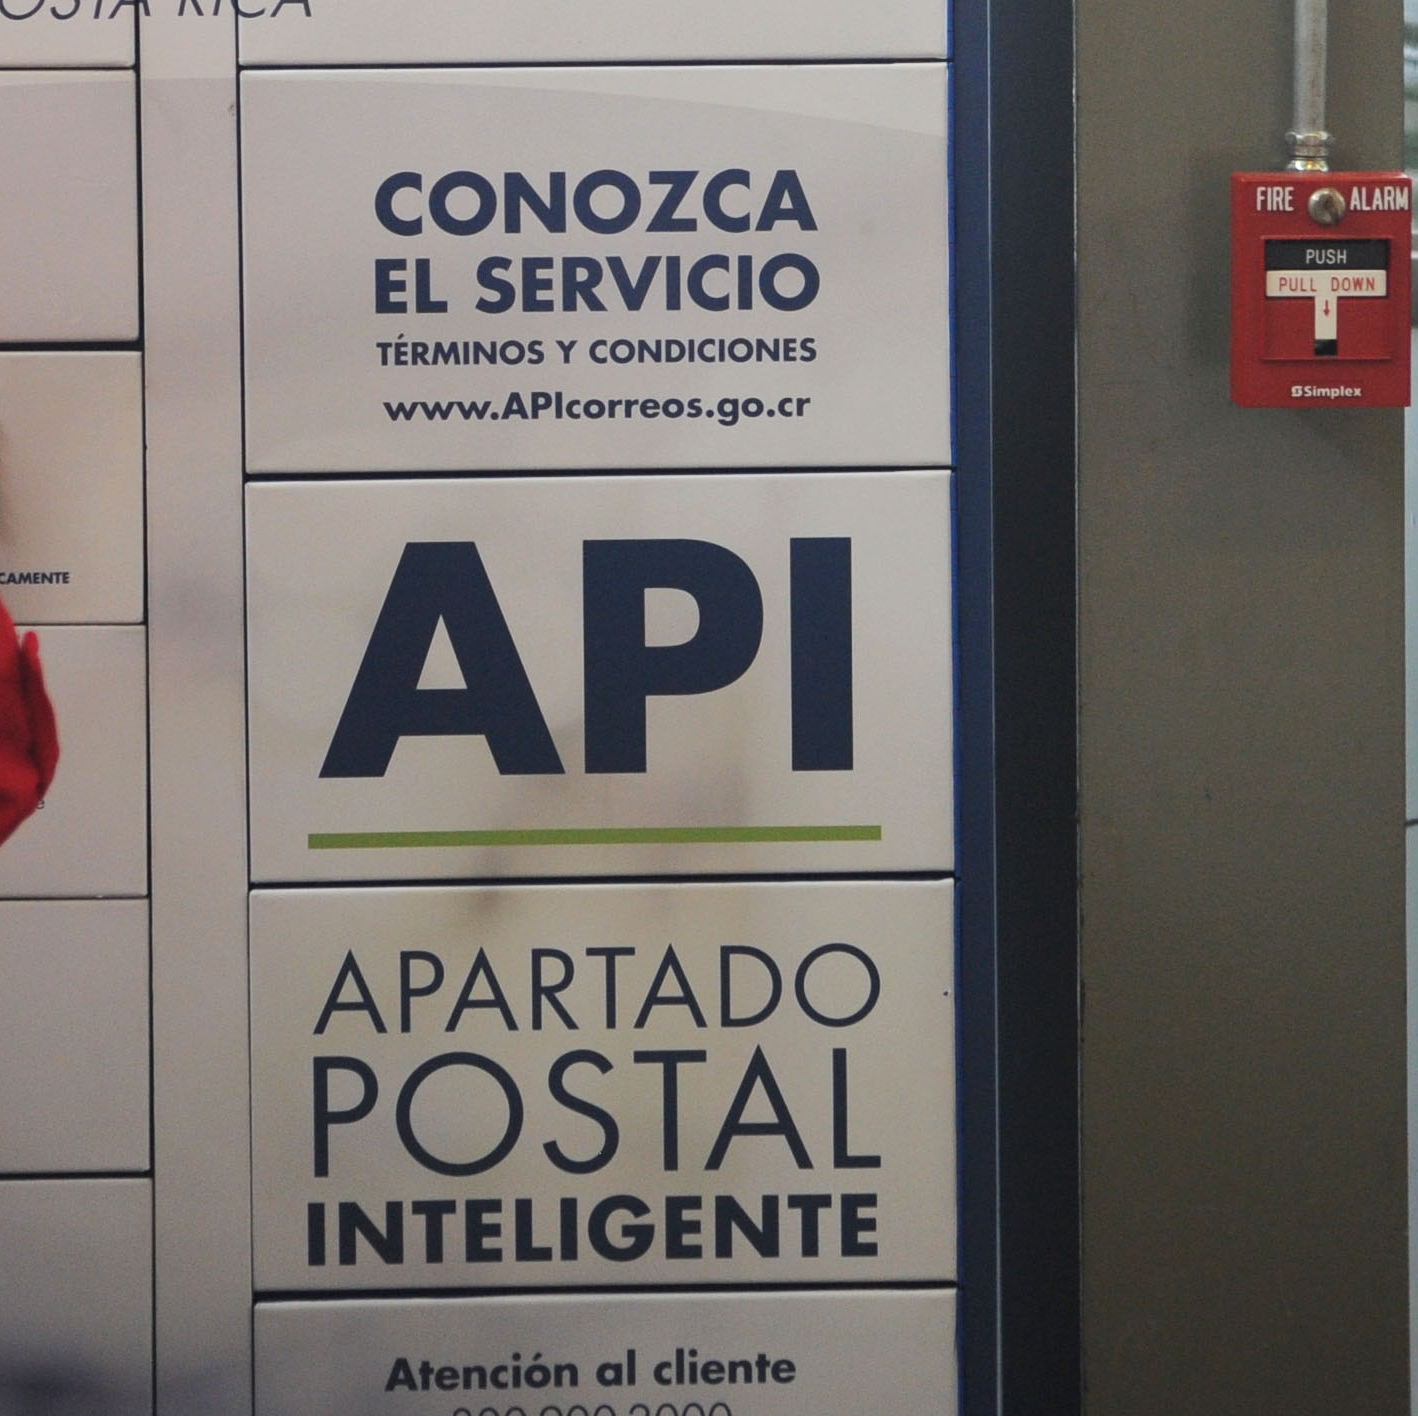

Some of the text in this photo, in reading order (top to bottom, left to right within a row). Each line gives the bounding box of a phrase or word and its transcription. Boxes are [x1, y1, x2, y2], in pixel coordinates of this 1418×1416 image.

[375, 169, 818, 236] CONOZCA
[1256, 186, 1409, 211] FIRE ALARM
[1305, 249, 1347, 264] PUSH
[375, 253, 820, 314] EL SERVICIO
[1279, 277, 1375, 291] PULL DOWN
[376, 333, 817, 366] TÉRMINOS Y CONDICIONES
[383, 391, 811, 426] www.APIcorreos.go.cr
[1304, 385, 1362, 399] Simplex
[318, 537, 853, 778] API
[313, 943, 881, 1035] APARTADO
[313, 1044, 881, 1177] POSTAL
[307, 1194, 878, 1266] INTELIGENTE
[384, 1348, 796, 1392] Atención al cliente
